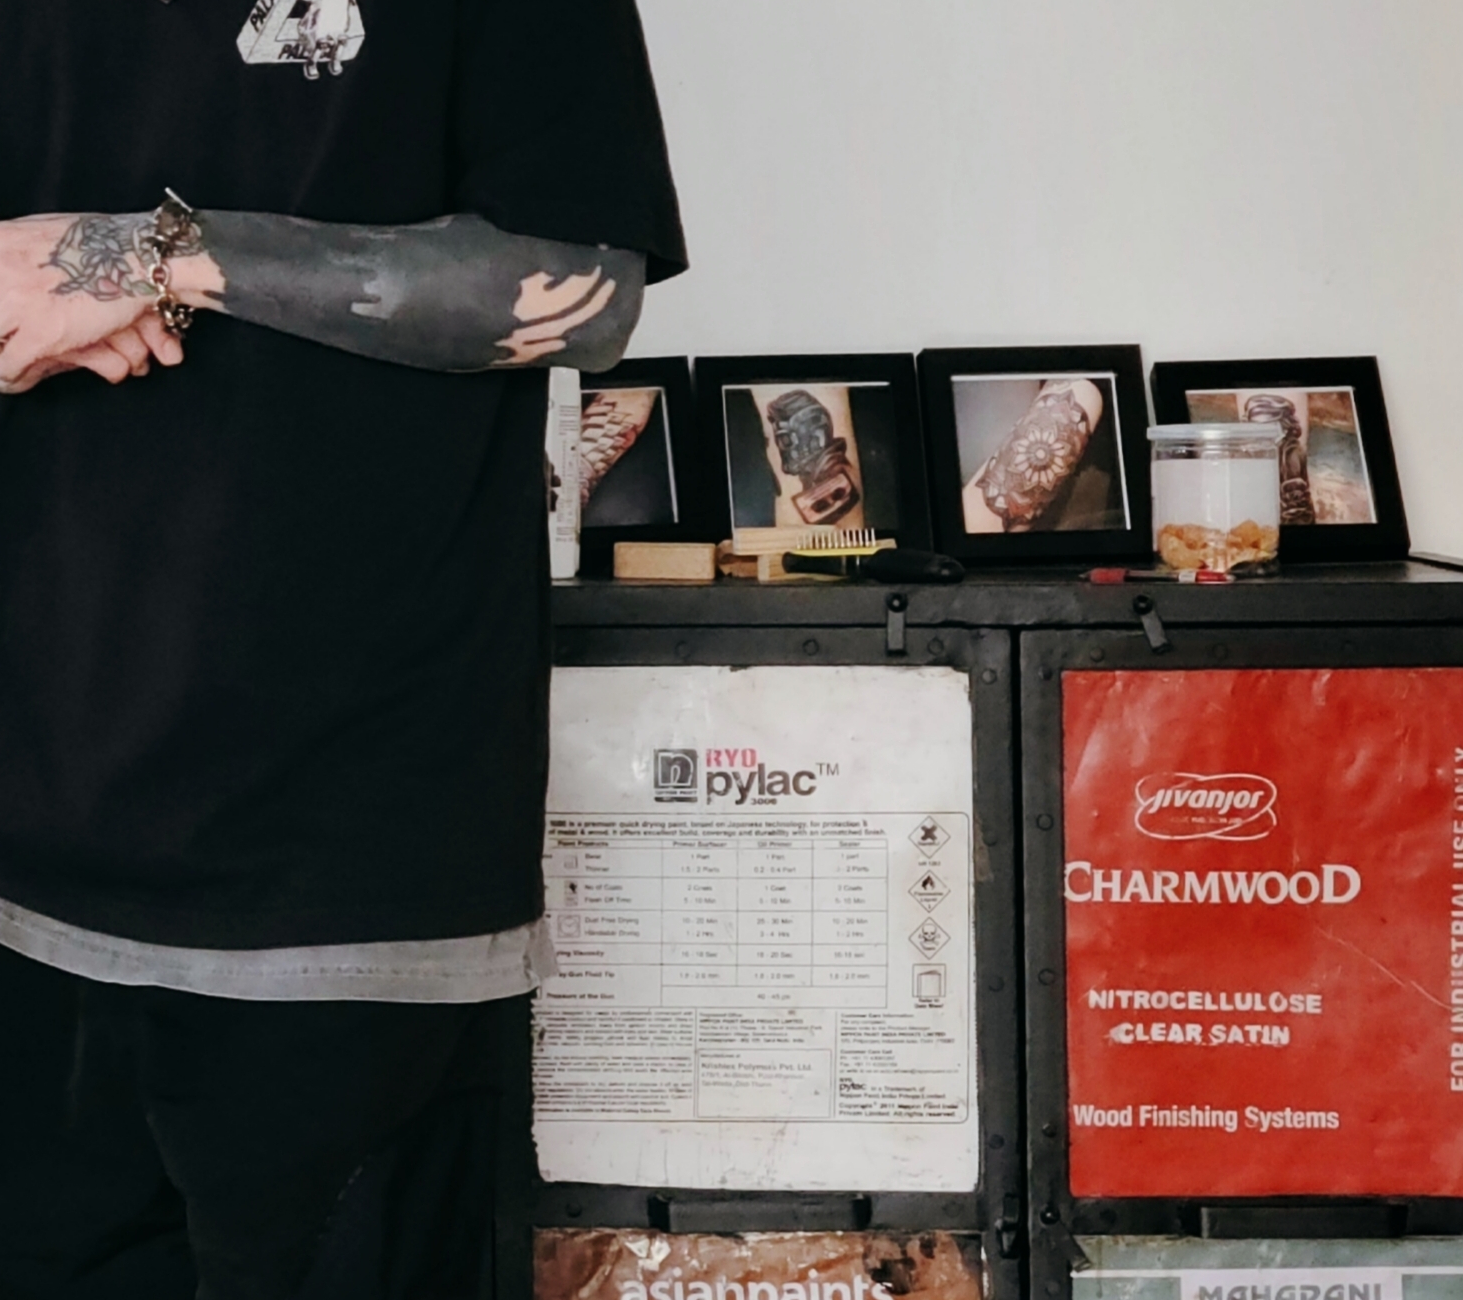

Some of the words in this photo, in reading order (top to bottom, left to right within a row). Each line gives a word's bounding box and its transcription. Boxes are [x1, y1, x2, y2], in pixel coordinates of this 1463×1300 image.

[706, 748, 757, 768] RYO
[706, 762, 818, 806] pylac
[1147, 787, 1265, 814] jivanjor
[618, 820, 640, 829] quick
[641, 820, 666, 829] drying
[727, 820, 763, 829] Japanese
[821, 820, 861, 829] protection
[619, 829, 641, 837] offers
[642, 829, 678, 837] excellent
[738, 829, 753, 837] and
[754, 829, 790, 837] durability
[791, 829, 808, 837] with
[1062, 861, 1362, 904] CHARMWOOD
[1088, 989, 1323, 1014] NITROCELLULOSE
[1115, 1022, 1202, 1045] CLEAR
[1210, 1025, 1291, 1047] SATIN
[1072, 1104, 1133, 1127] Wood
[1139, 1104, 1238, 1133] Finishing
[1244, 1106, 1340, 1132] Systems
